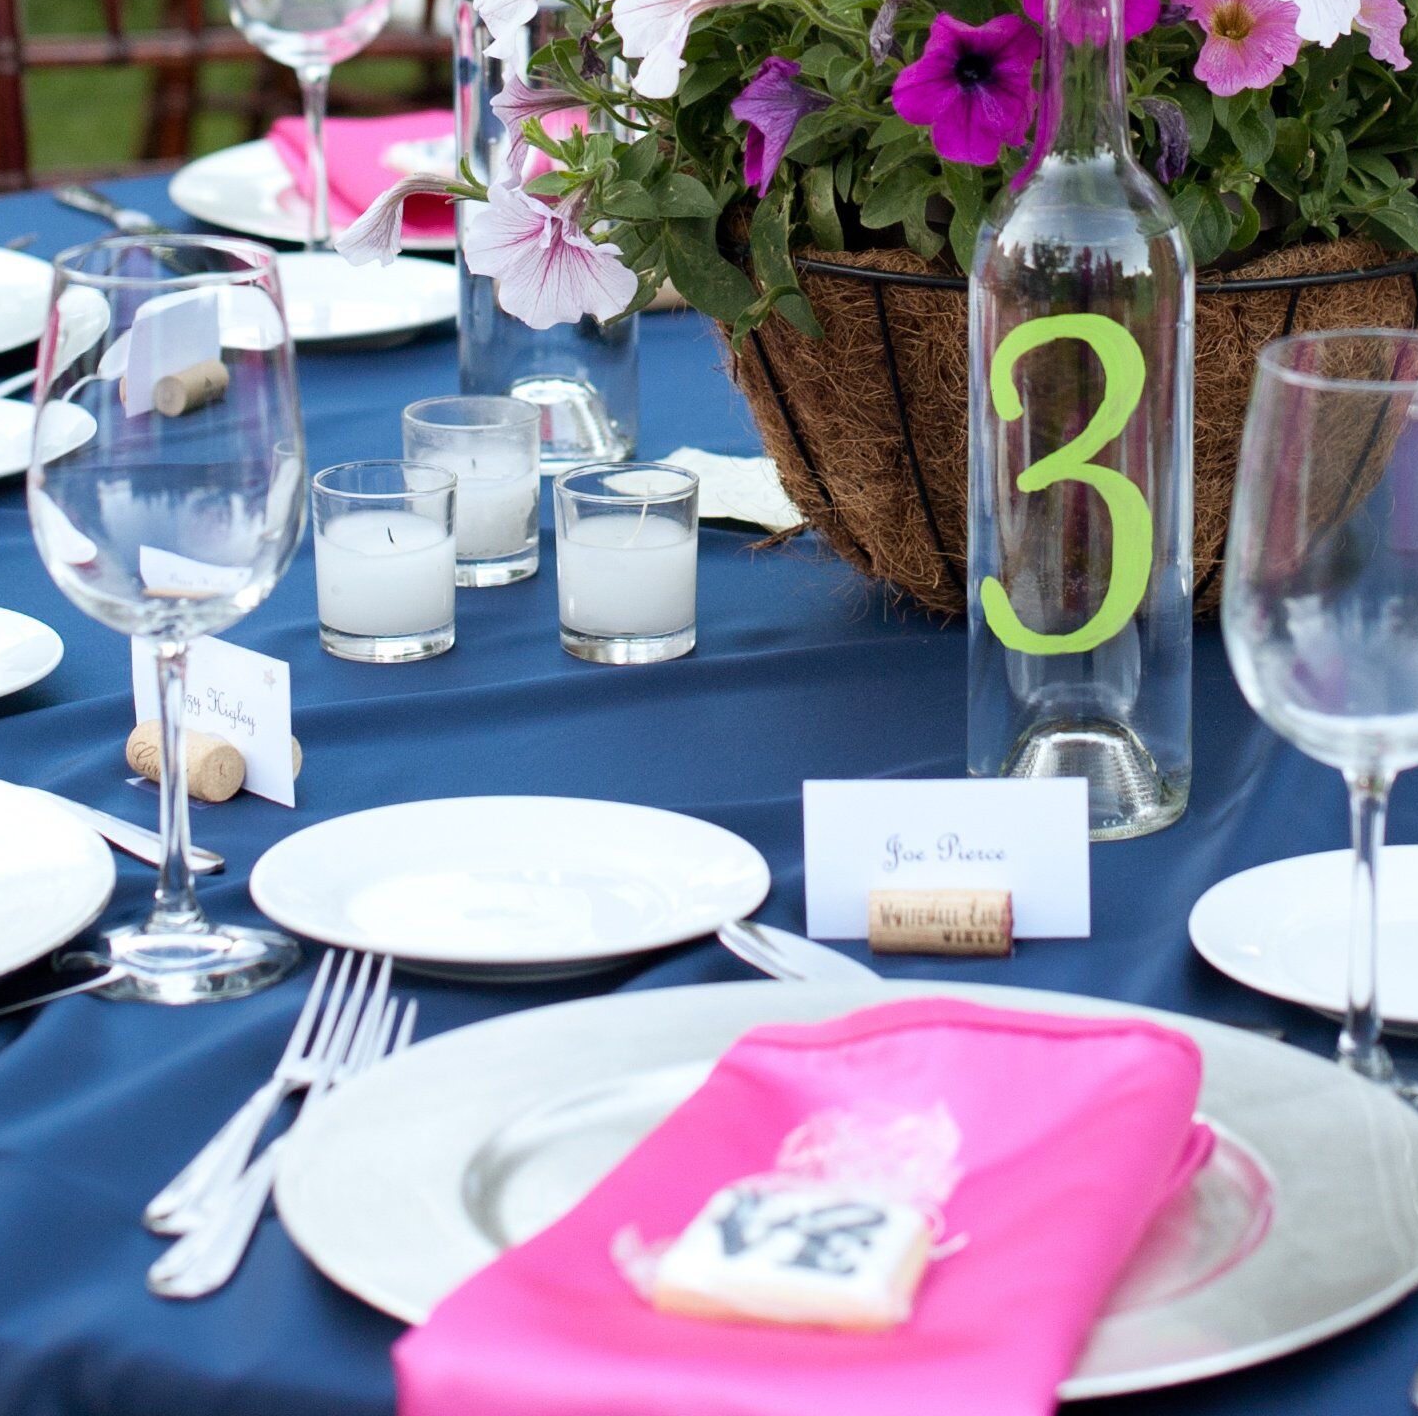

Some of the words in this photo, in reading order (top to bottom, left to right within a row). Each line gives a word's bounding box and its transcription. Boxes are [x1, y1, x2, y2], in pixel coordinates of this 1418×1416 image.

[980, 313, 1153, 655] 3
[882, 833, 925, 873] Joe
[936, 832, 1006, 861] Pierce
